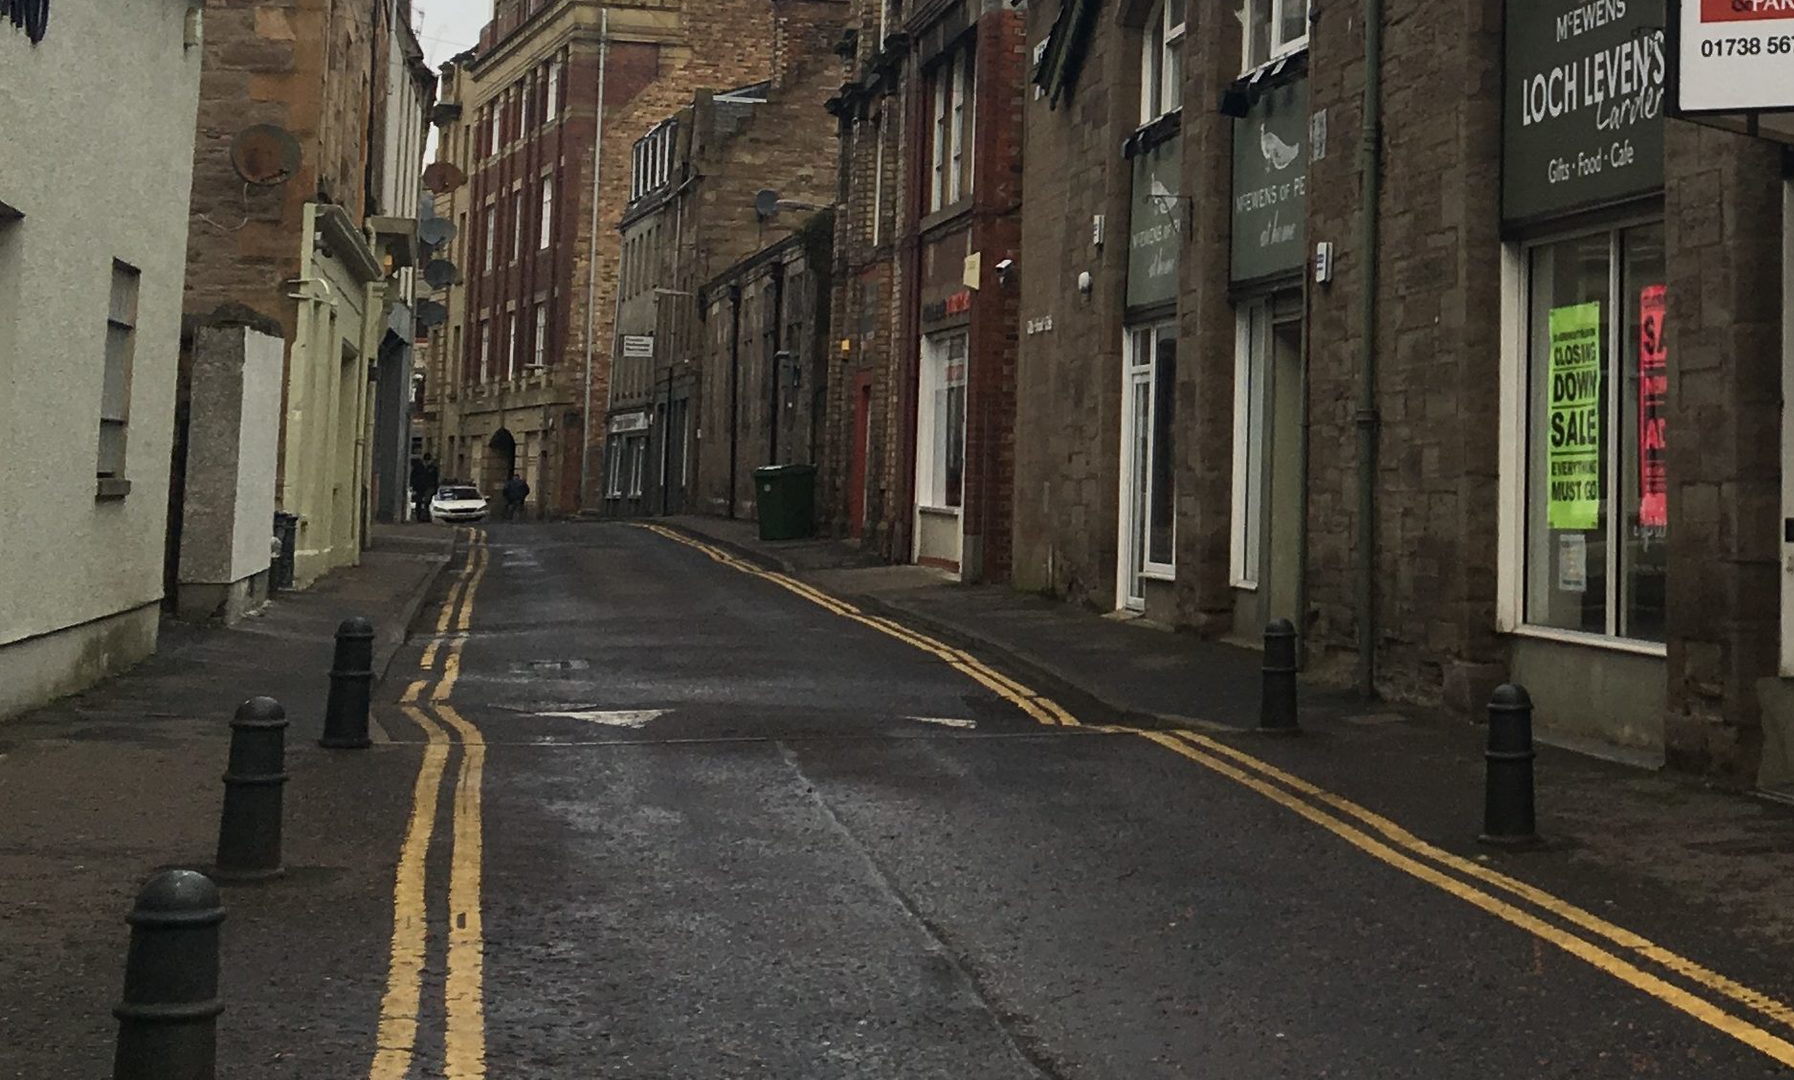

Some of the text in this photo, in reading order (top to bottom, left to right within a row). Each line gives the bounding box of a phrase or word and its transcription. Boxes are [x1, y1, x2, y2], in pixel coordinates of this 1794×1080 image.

[1701, 37, 1761, 58] 01738
[1522, 60, 1577, 126] LOCH
[1578, 147, 1603, 177] Food
[1554, 342, 1596, 367] CLOSING
[1553, 371, 1597, 403] DOWN
[1551, 407, 1597, 448] SALE
[1551, 480, 1582, 502] MUST
